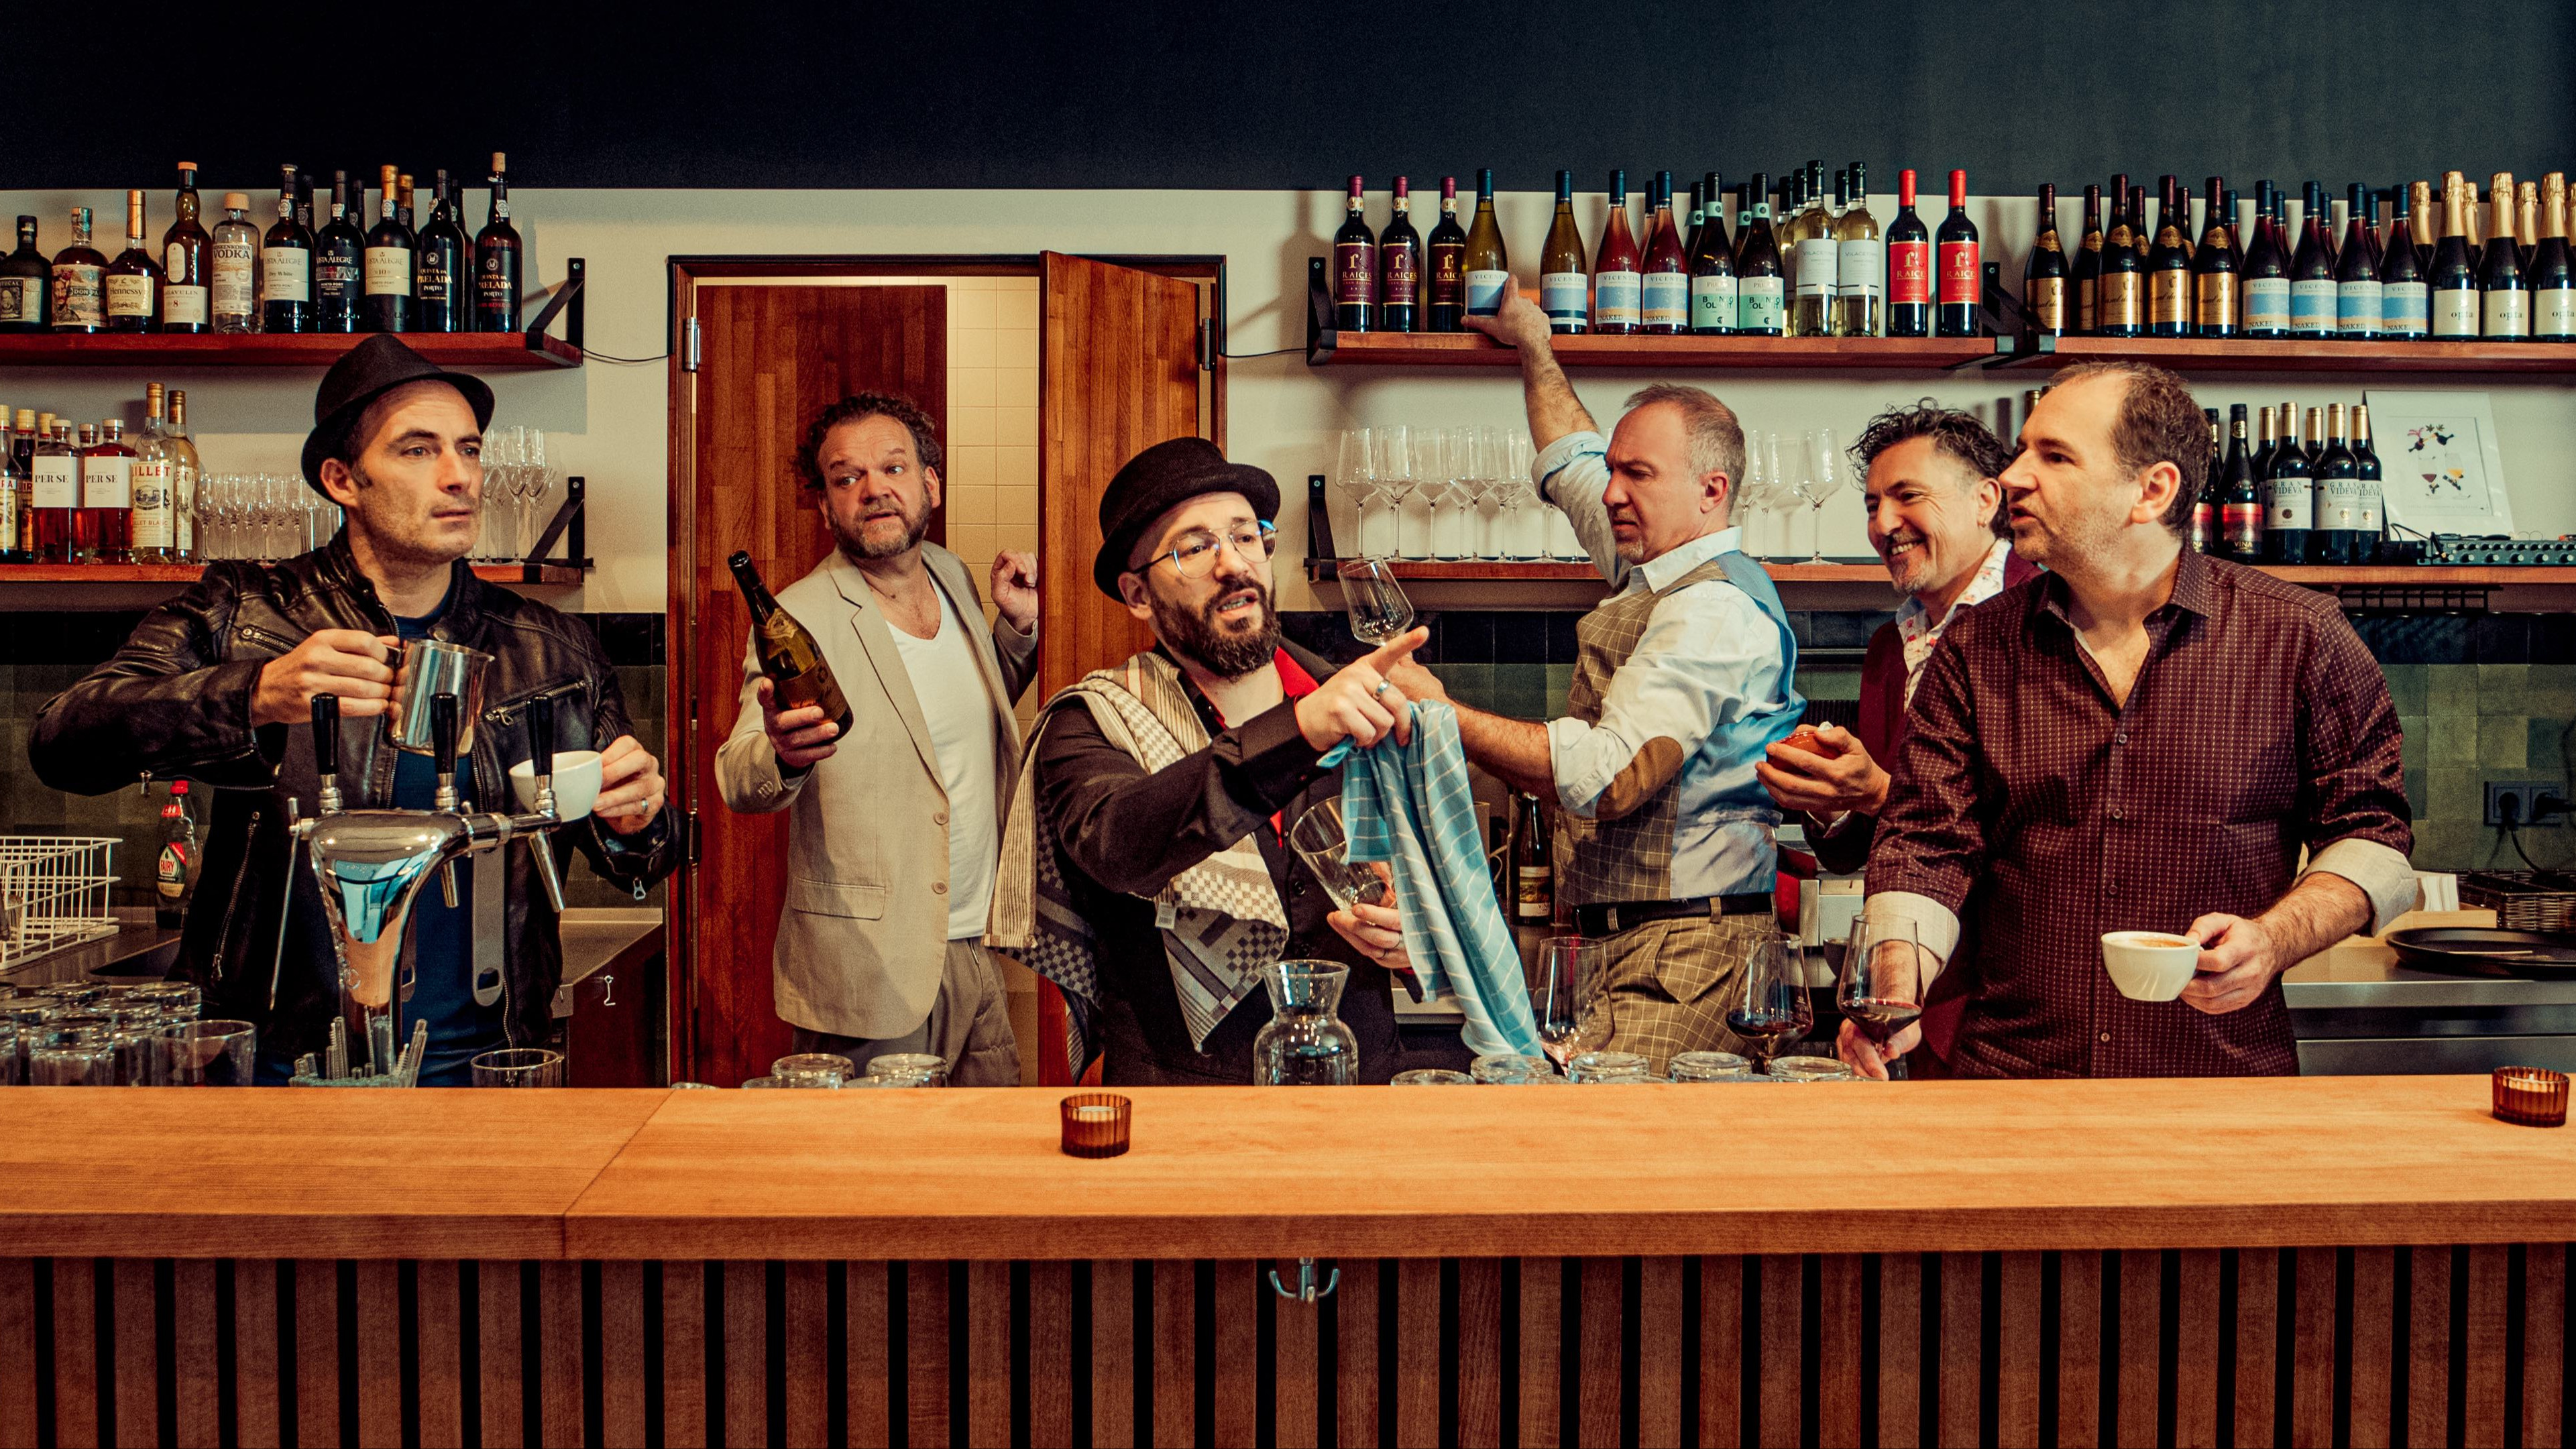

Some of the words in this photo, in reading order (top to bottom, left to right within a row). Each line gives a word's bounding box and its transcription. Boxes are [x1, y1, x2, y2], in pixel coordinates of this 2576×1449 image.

[213, 249, 251, 259] VODKA
[277, 257, 302, 266] ALEGRE
[328, 256, 353, 264] ALEGRE
[379, 257, 403, 265] ALEGRE
[1343, 271, 1371, 279] RAICES
[1387, 271, 1417, 279] RAICES
[416, 275, 453, 284] PRELADA
[109, 287, 143, 296] Hennessy
[172, 300, 179, 308] 8
[1702, 296, 1734, 304] BNO
[1749, 296, 1781, 304] BNO
[35, 474, 54, 483] PER
[56, 474, 69, 483] SE
[86, 474, 105, 483] PER
[105, 474, 119, 483] SE
[160, 860, 175, 872] FAIRY
